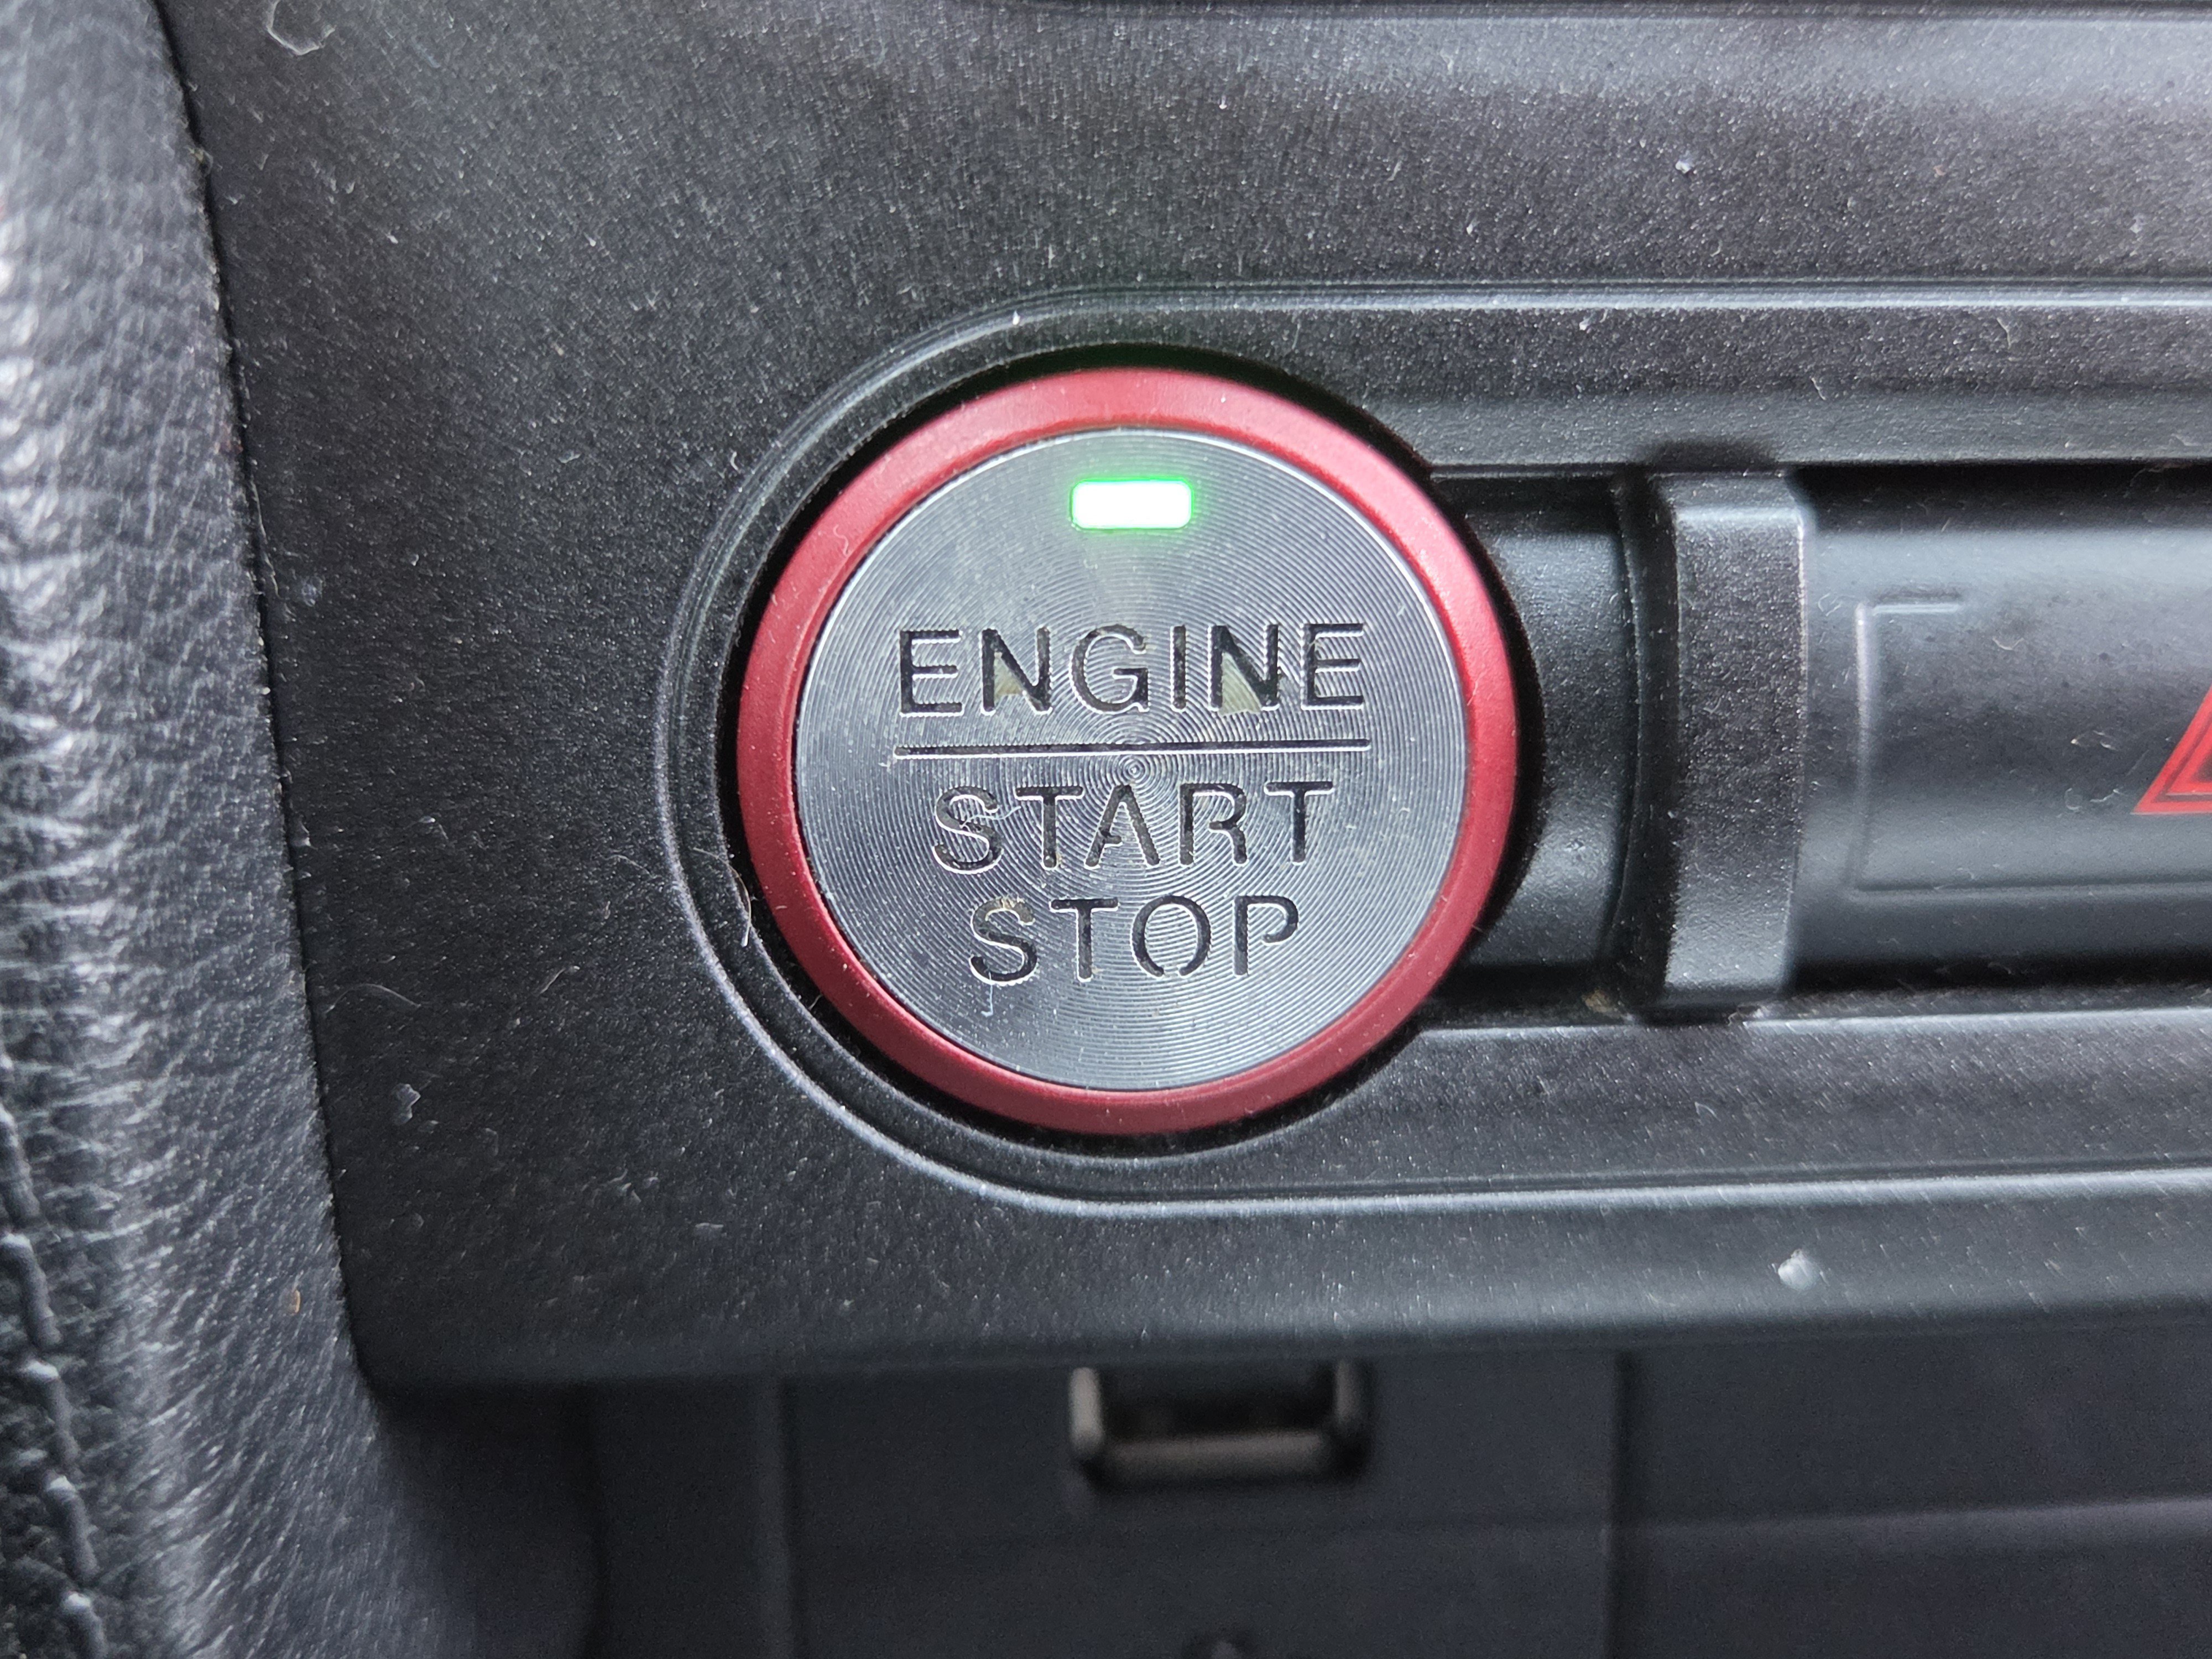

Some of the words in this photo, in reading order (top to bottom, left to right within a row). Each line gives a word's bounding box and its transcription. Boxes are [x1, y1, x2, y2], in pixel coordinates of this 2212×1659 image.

[899, 623, 1364, 716] ENGINE
[933, 781, 1334, 874] START
[969, 895, 1299, 985] STOP
